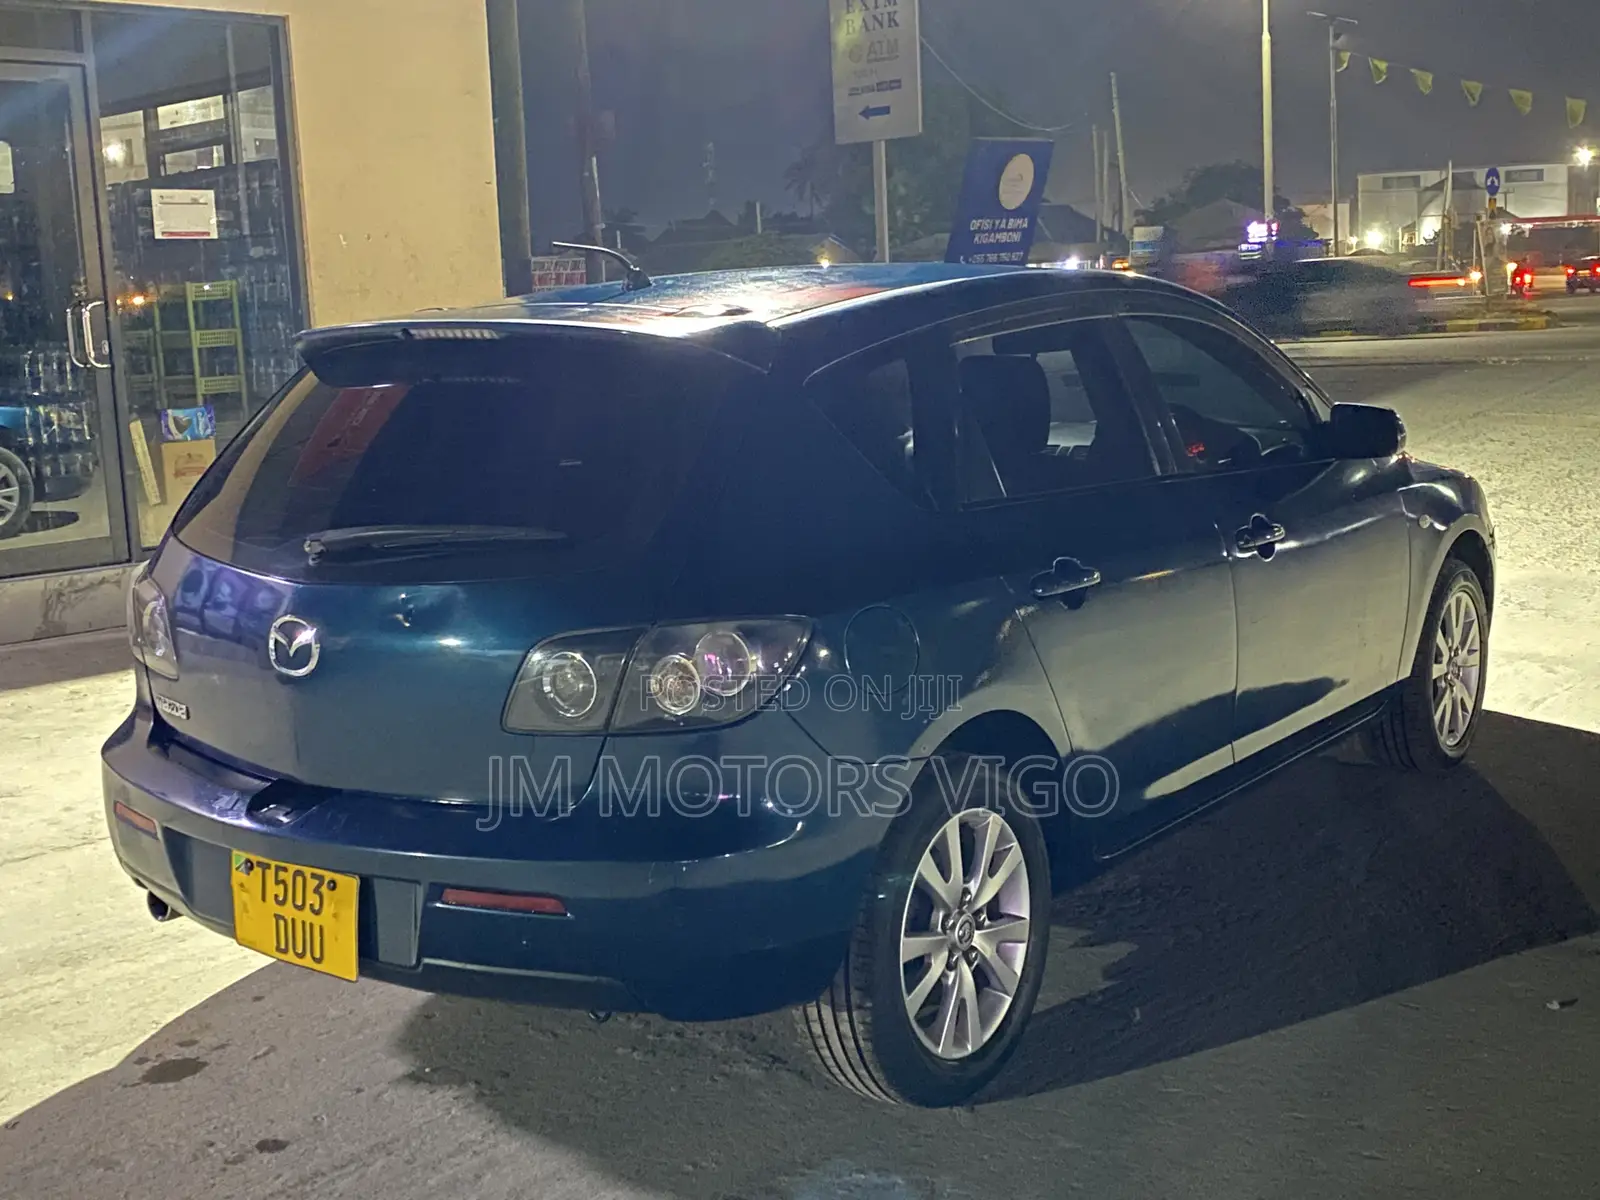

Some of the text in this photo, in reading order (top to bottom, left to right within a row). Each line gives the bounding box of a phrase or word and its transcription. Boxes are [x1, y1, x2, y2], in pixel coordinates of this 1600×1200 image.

[845, 11, 899, 35] BANK
[867, 38, 899, 58] ATM
[970, 217, 1029, 231] OFISI YA BIMA
[973, 231, 1022, 244] KIGAMBONI
[256, 861, 325, 916] T503
[273, 912, 325, 964] DUU
